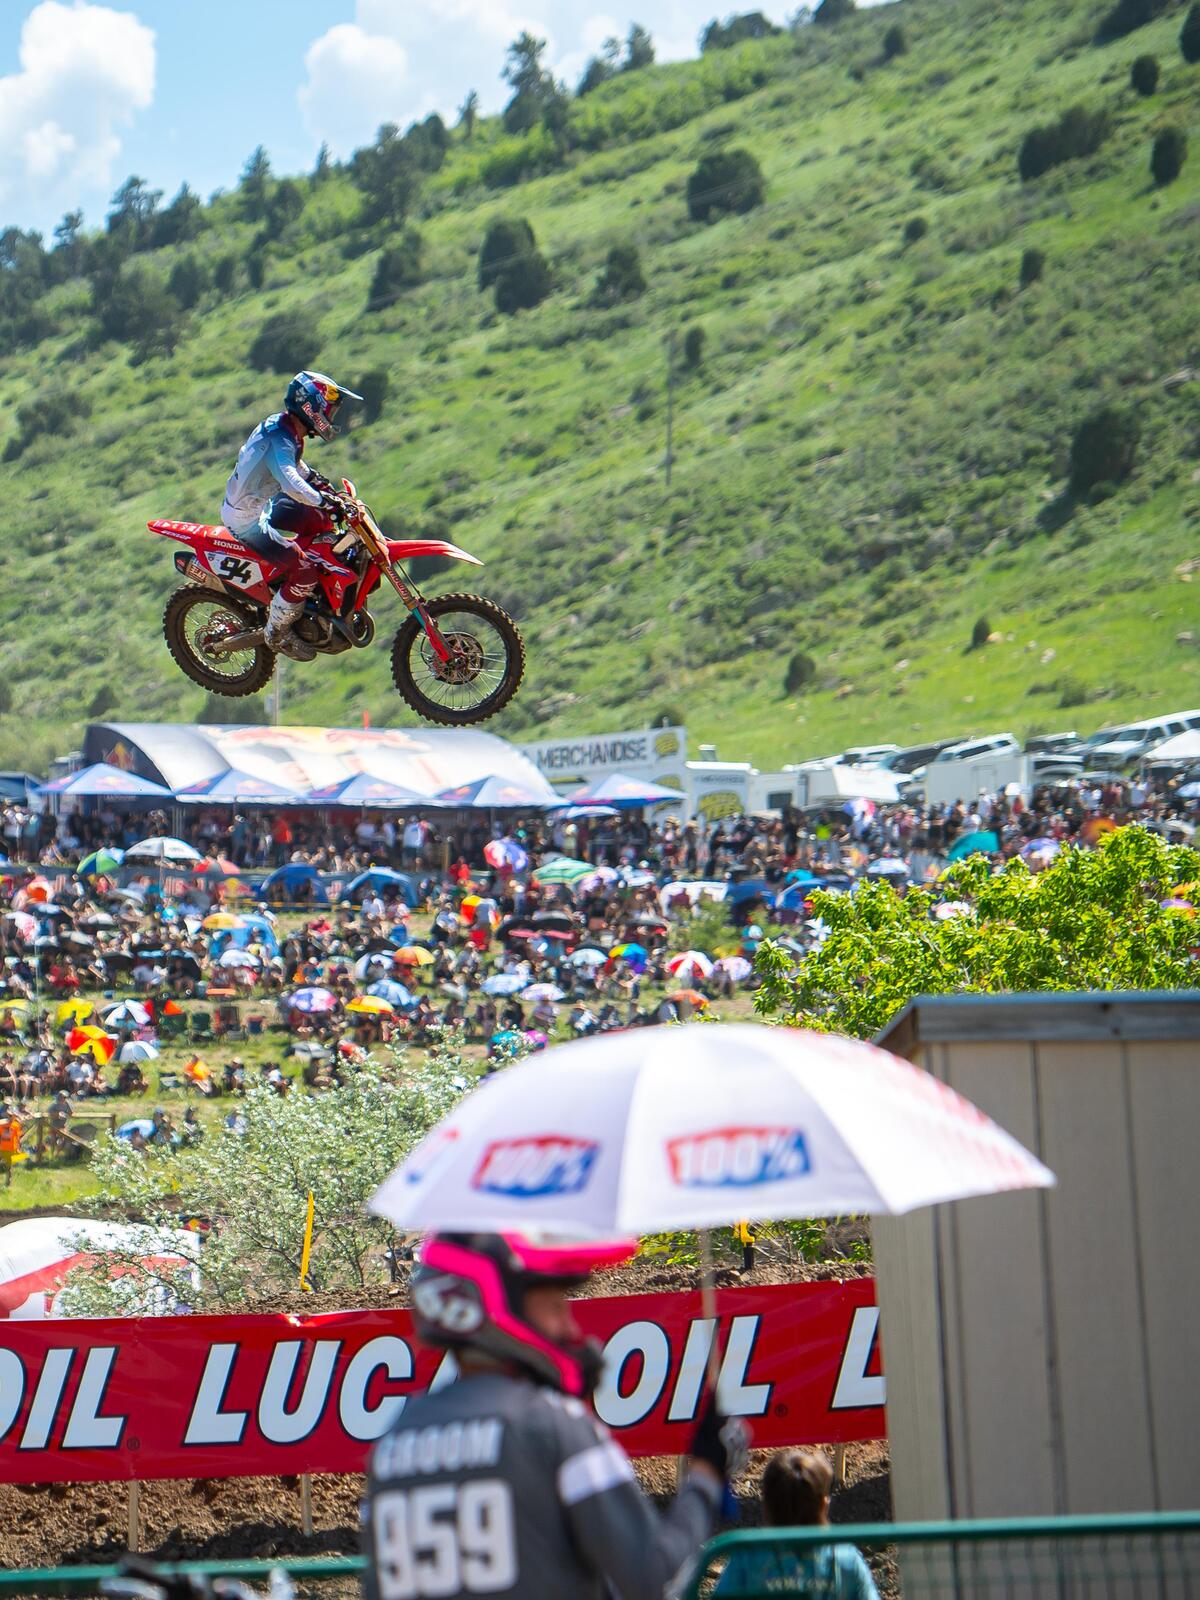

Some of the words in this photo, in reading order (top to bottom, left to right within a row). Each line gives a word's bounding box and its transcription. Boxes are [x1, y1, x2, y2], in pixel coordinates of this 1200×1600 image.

[213, 540, 246, 552] HONDA
[219, 556, 252, 584] 94
[537, 737, 647, 769] MERCHANDISE
[674, 1130, 806, 1184] 100%
[595, 1314, 775, 1429] OIL
[374, 1478, 518, 1599] 959
